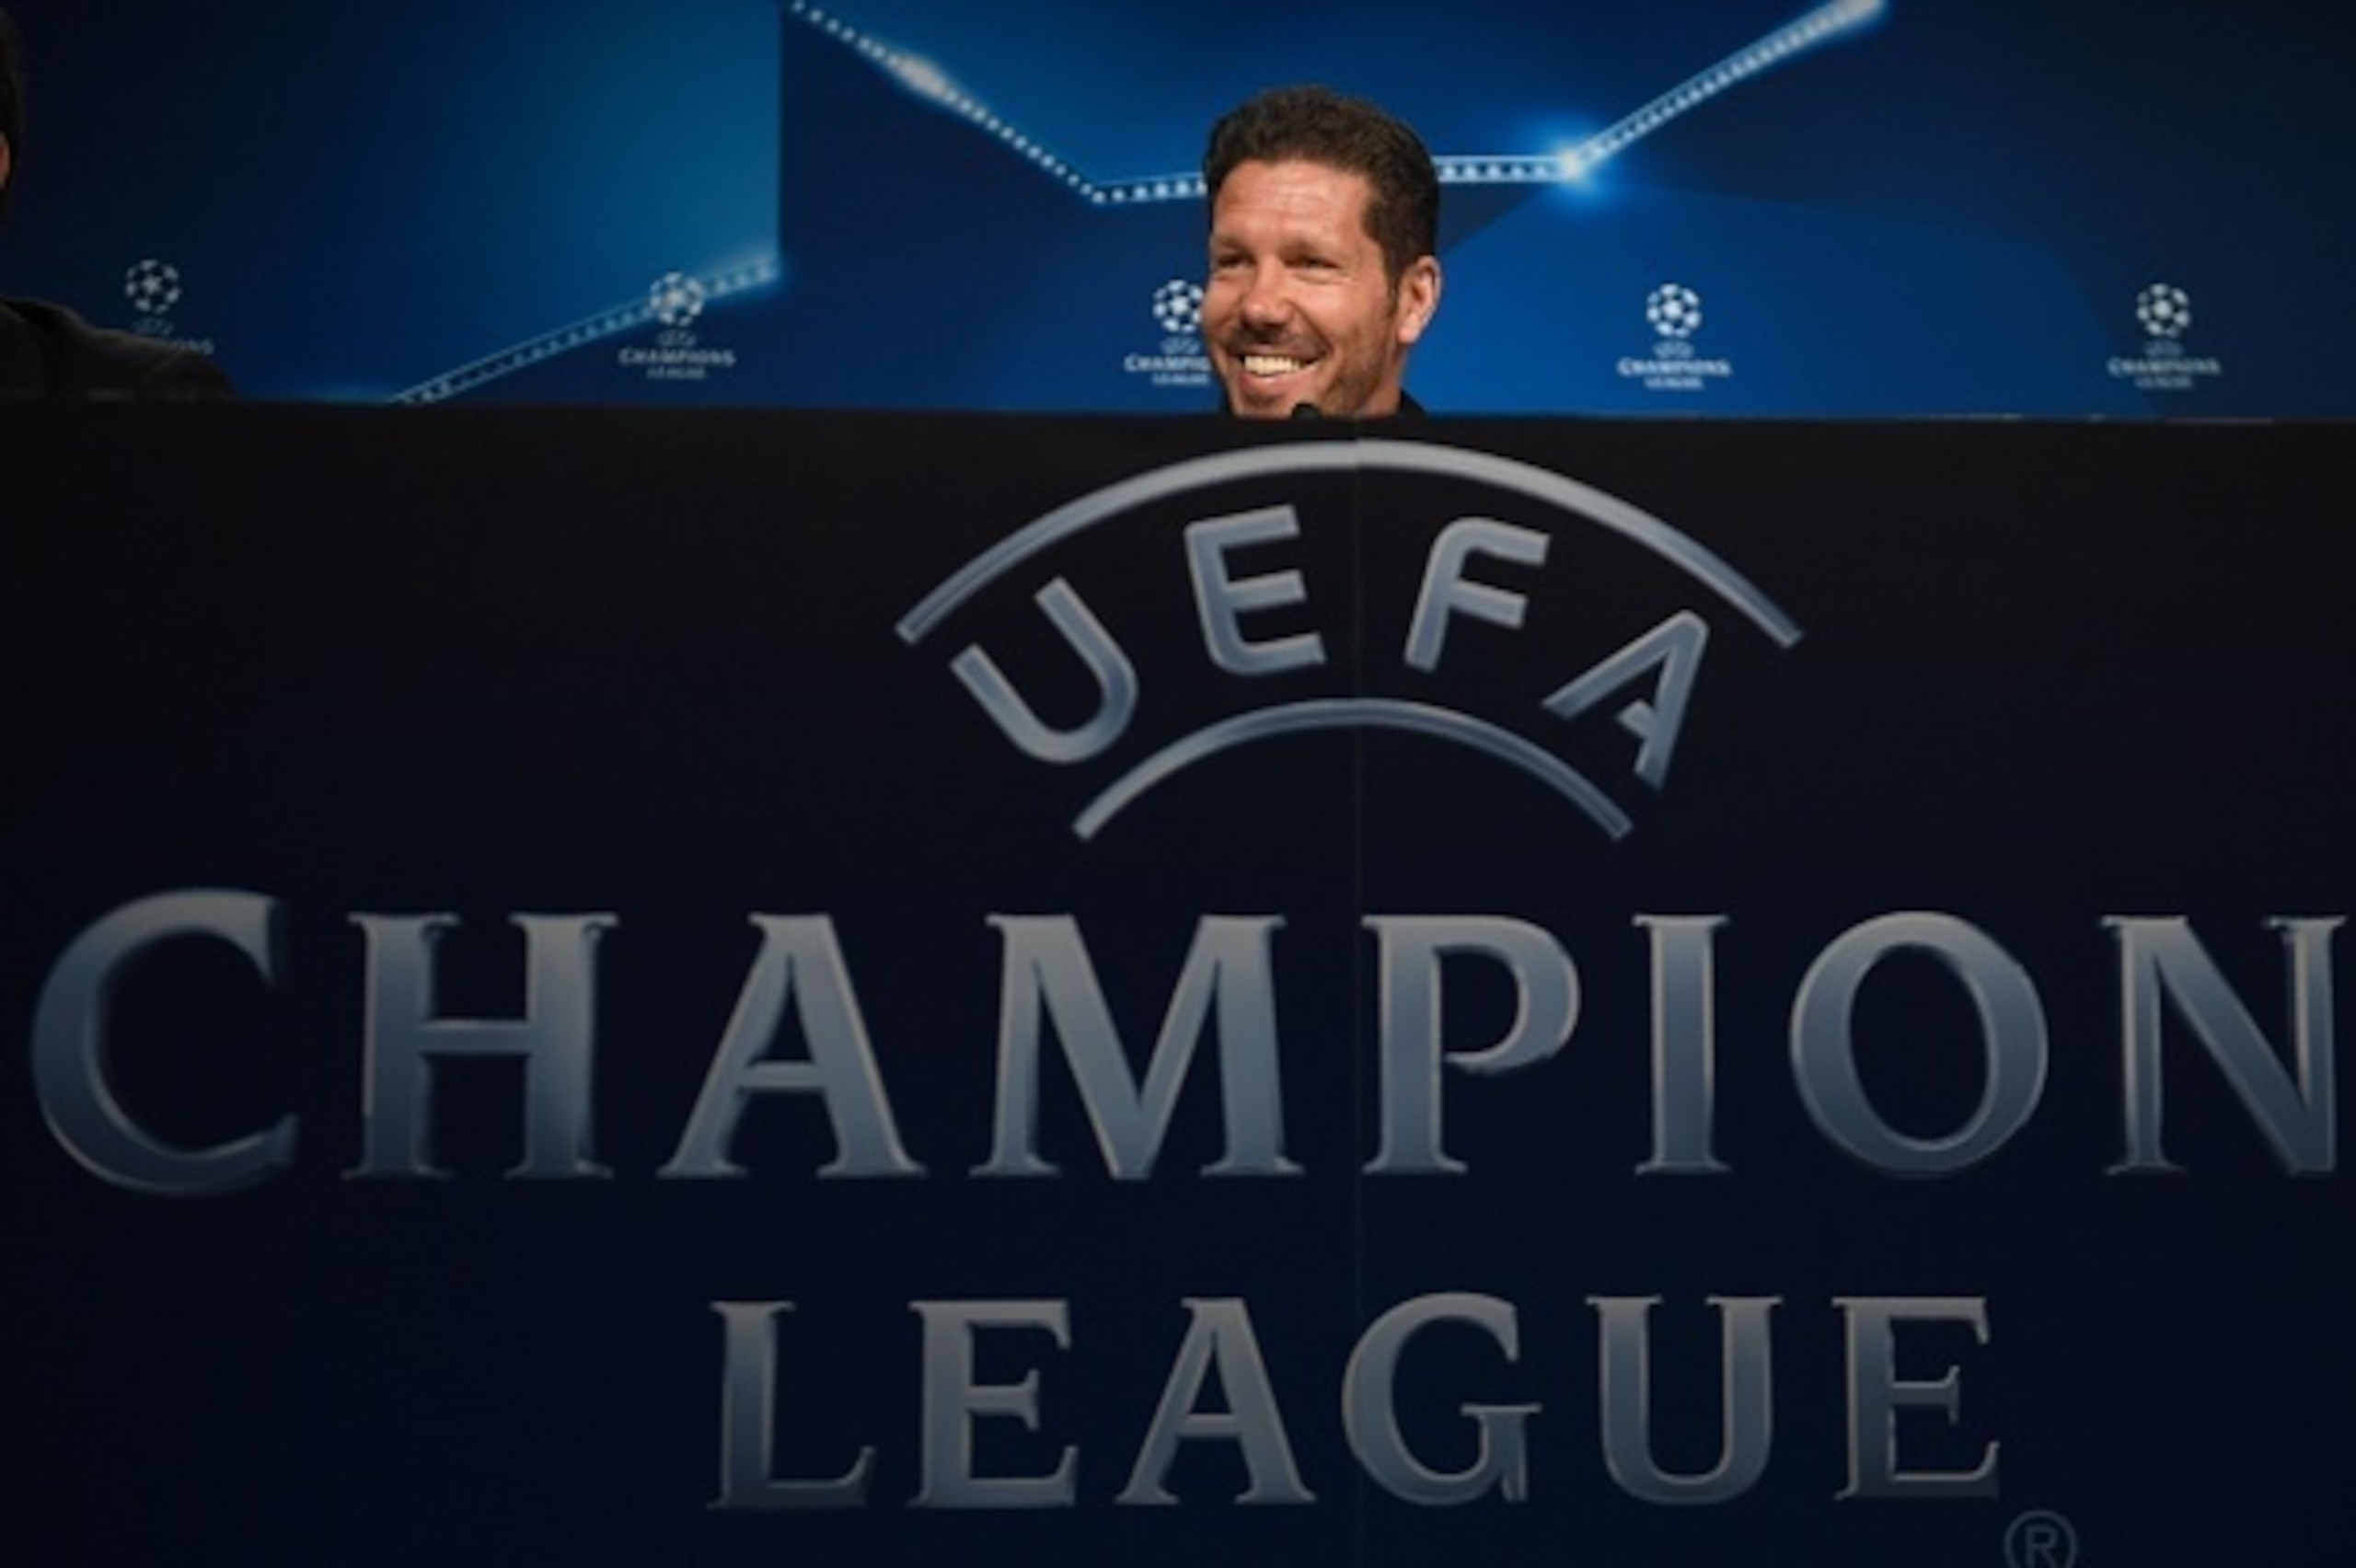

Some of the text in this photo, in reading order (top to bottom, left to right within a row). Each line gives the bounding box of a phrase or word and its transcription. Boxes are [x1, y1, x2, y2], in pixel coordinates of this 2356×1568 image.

[949, 503, 1709, 788] UEFA
[31, 889, 2347, 1197] CHAMPION
[708, 1293, 2001, 1512] LEAGUE
